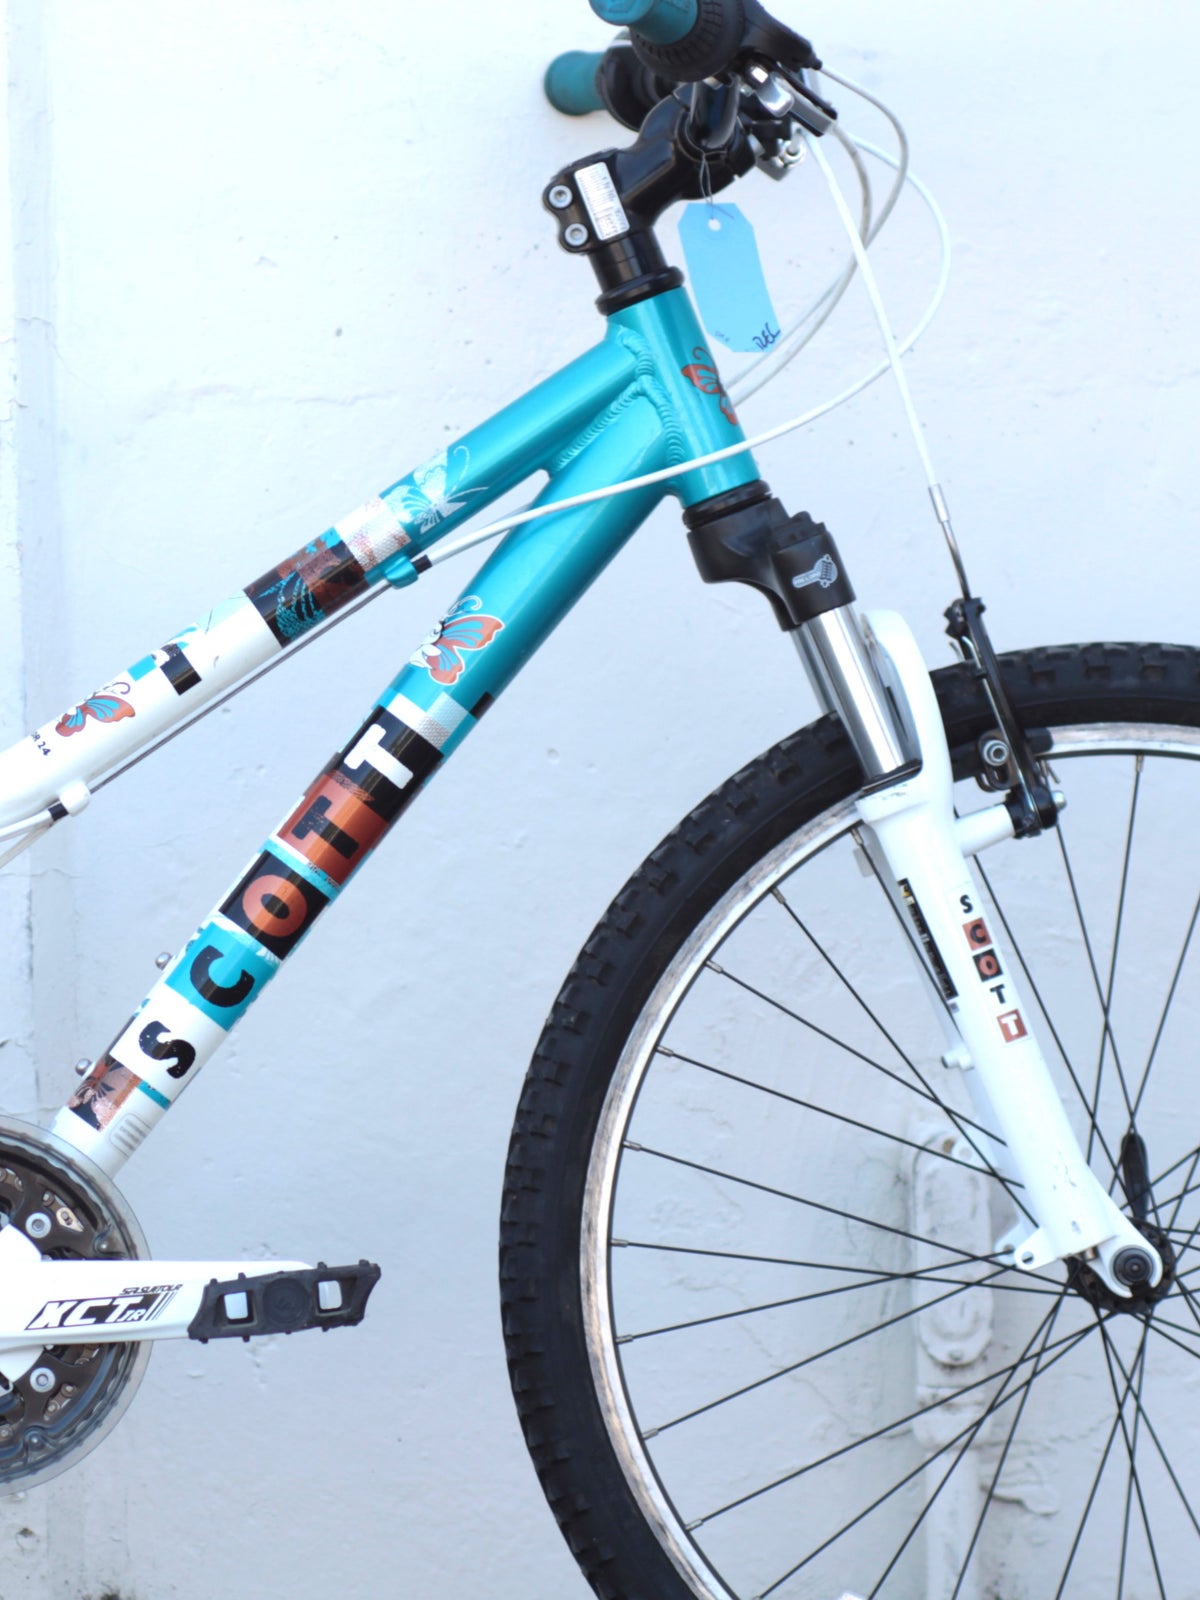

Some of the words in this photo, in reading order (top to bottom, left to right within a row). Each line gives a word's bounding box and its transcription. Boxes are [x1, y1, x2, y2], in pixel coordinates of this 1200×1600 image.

[38, 741, 51, 755] 24
[138, 723, 414, 1080] SCOTT
[959, 894, 1019, 1036] SCOTT
[28, 1296, 144, 1329] XCT
